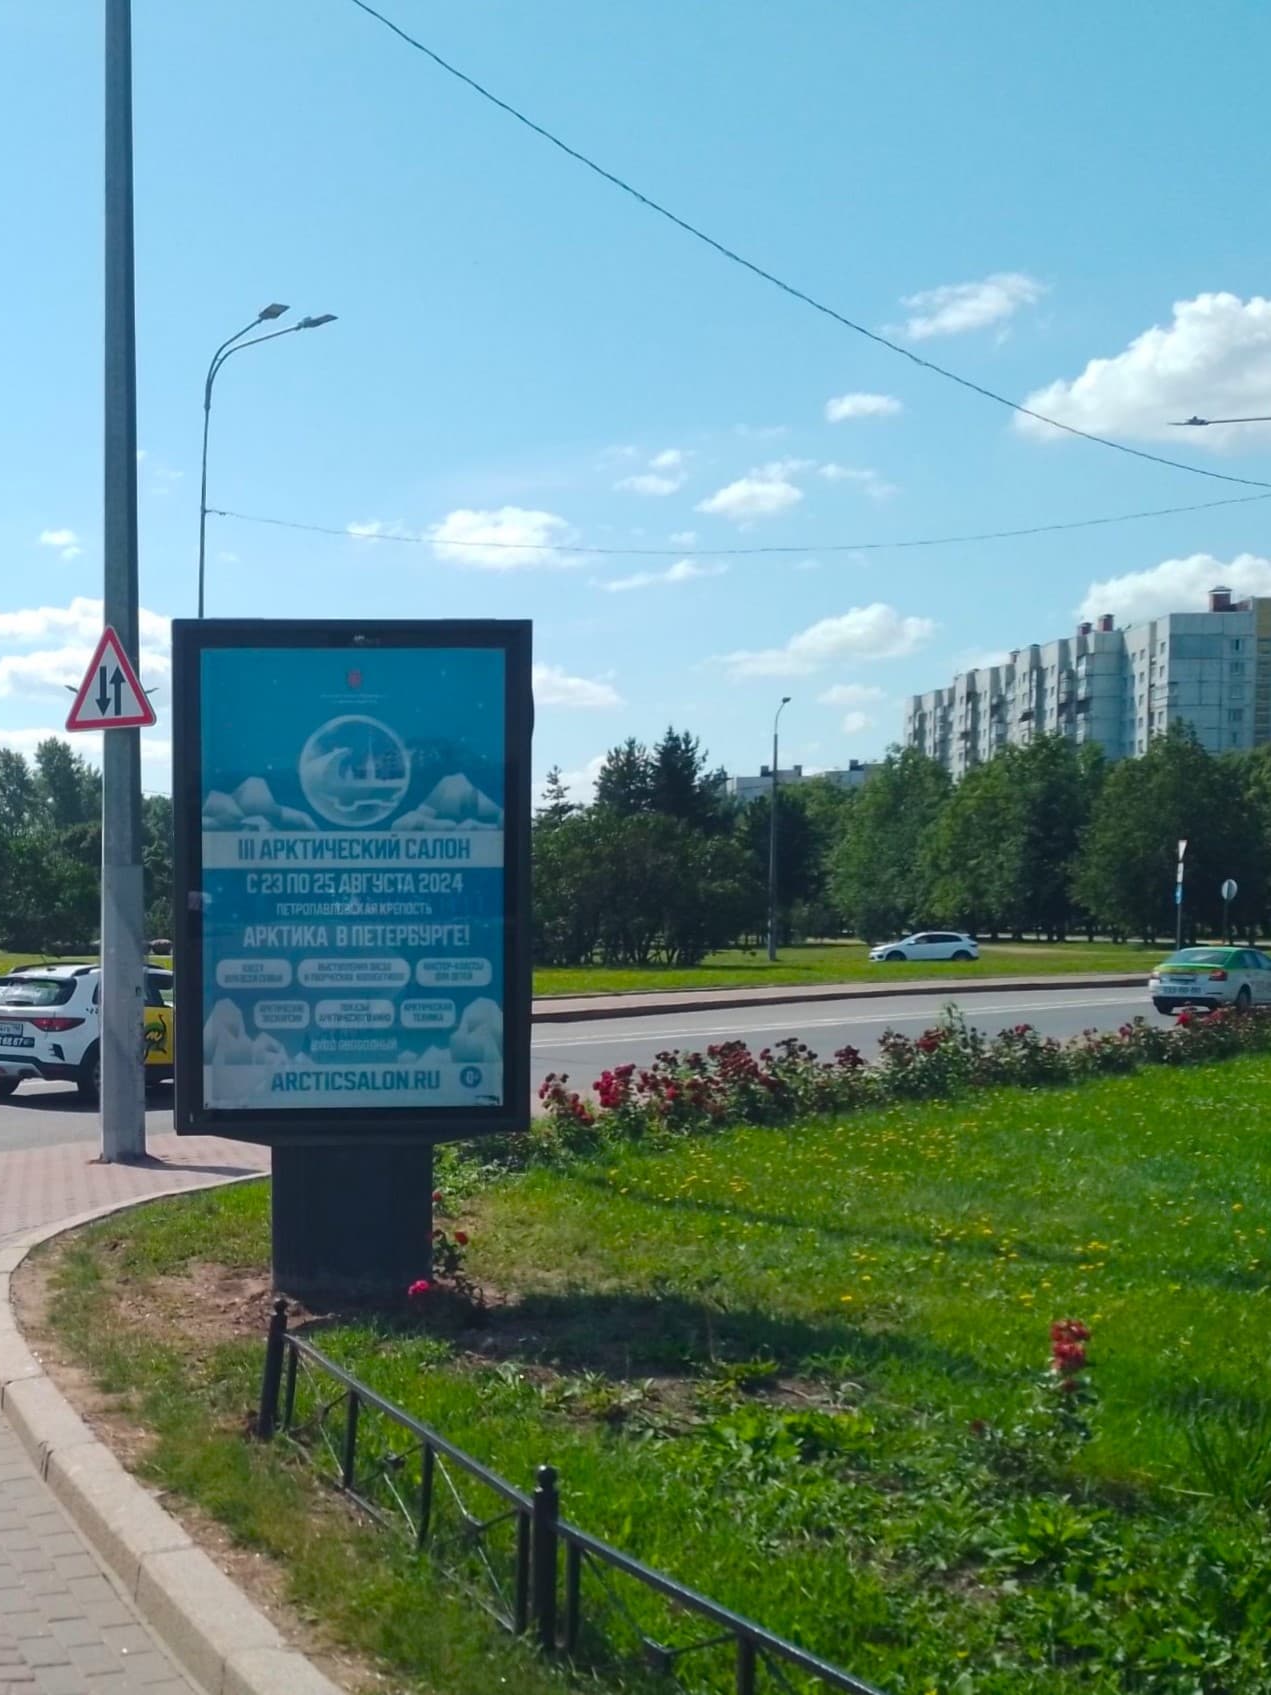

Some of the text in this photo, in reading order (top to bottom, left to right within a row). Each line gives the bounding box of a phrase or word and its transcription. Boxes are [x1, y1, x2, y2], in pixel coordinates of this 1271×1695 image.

[238, 835, 471, 861] III АРКТИЧЕСКИЙ САЛОН
[246, 872, 464, 894] С 23 ПО 25 АВГУСТА 2024
[277, 902, 433, 916] ПЕТРОПАВЛОВСКАЯ КРЕПОСТЬ
[243, 924, 470, 948] АРКТИКА В ПЕТЕРБУРГЕ!
[271, 1070, 441, 1092] ARCTICSALON.RU
